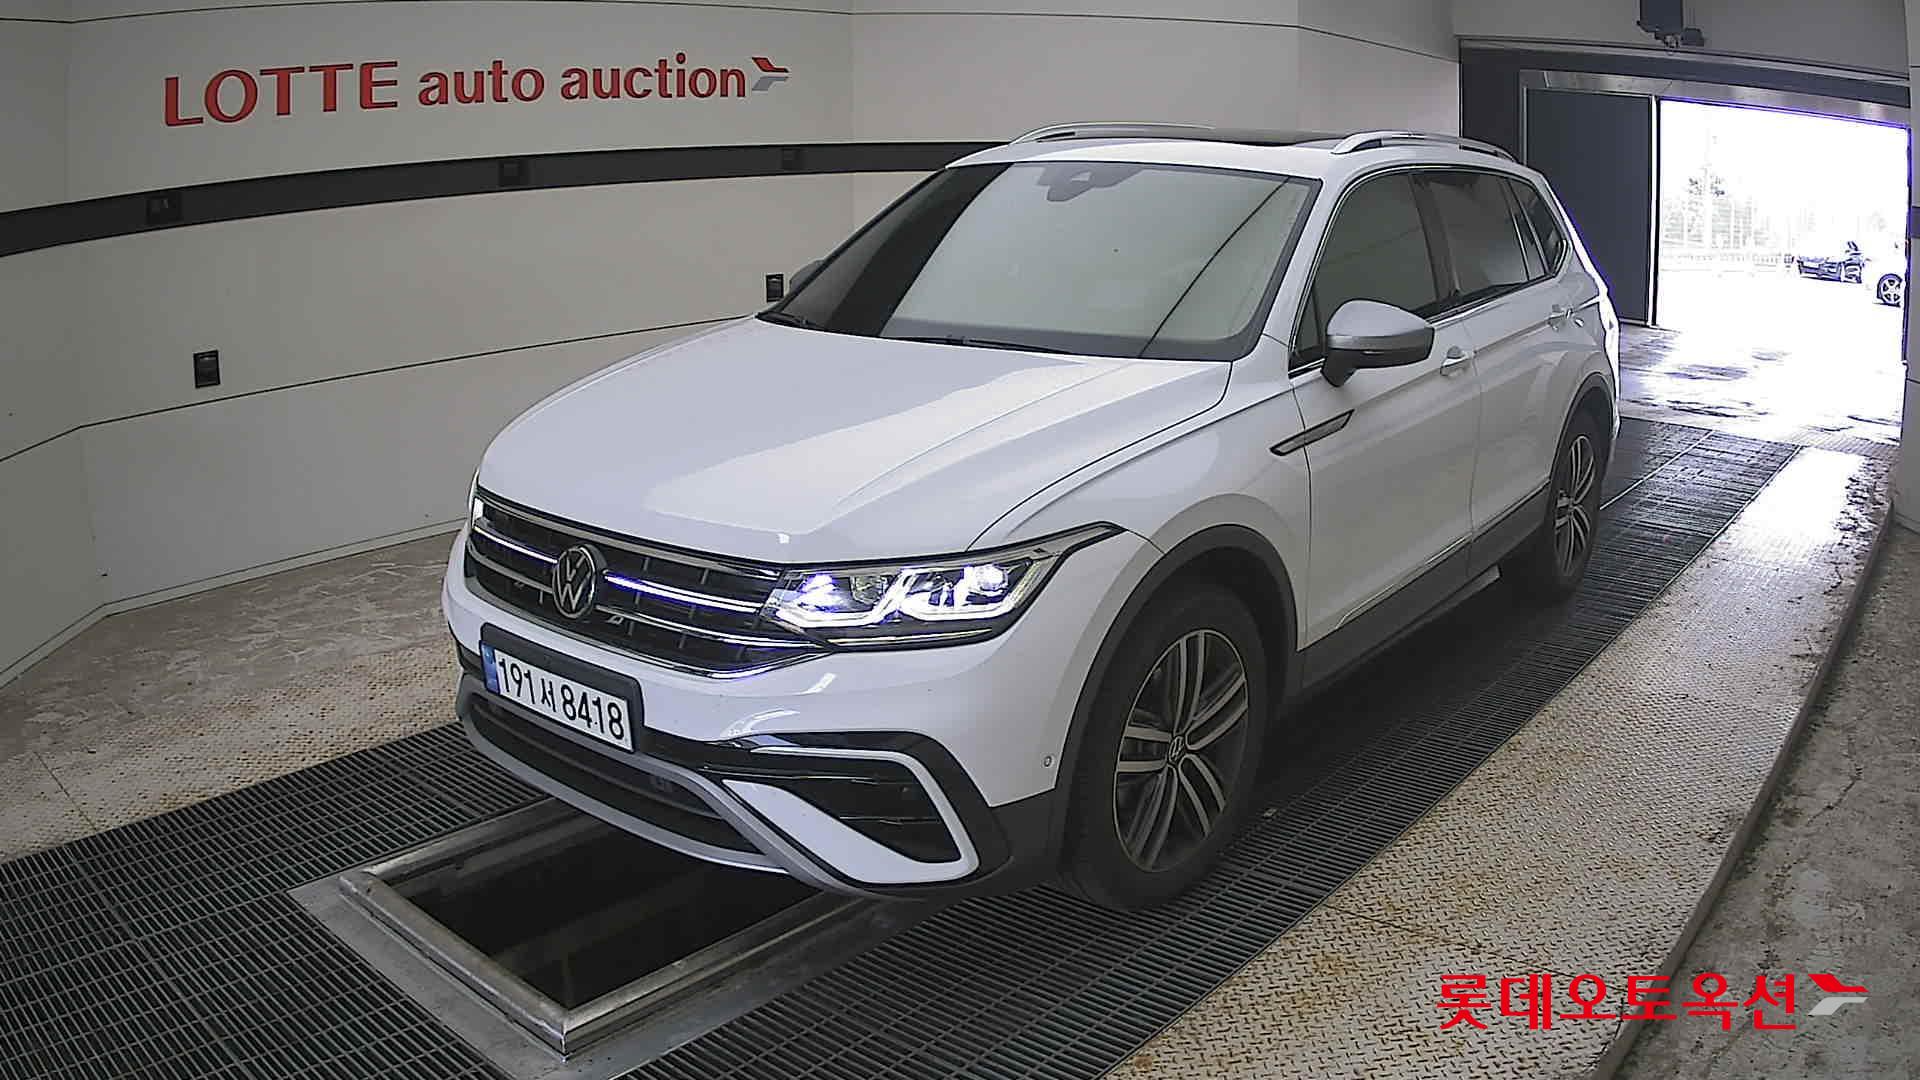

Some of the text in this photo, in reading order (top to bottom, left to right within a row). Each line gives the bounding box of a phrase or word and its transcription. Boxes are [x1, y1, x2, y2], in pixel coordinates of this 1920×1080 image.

[163, 52, 747, 127] LOTTE auto auction
